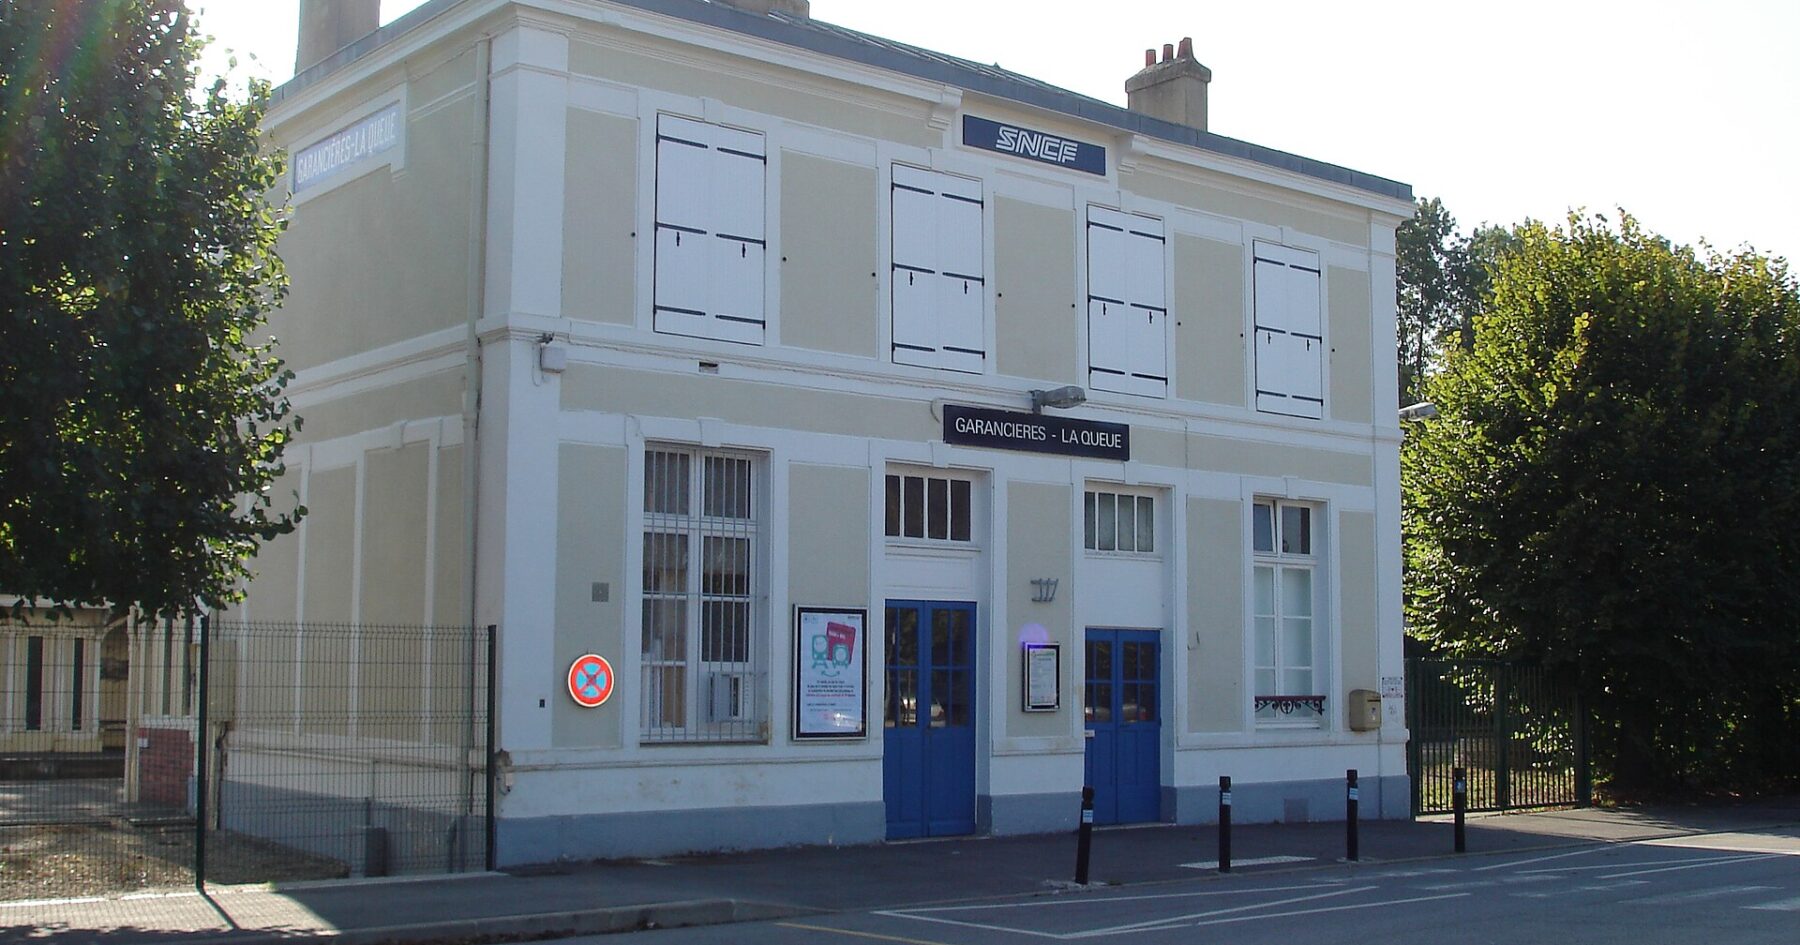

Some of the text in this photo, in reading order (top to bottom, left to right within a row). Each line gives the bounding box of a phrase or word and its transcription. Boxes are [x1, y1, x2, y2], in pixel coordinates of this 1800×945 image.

[368, 111, 396, 153] QUEUE
[995, 126, 1078, 163] SNCF
[955, 417, 1046, 441] GARANCIERES
[1062, 428, 1079, 444] LA
[1081, 430, 1122, 449] QUEUE
